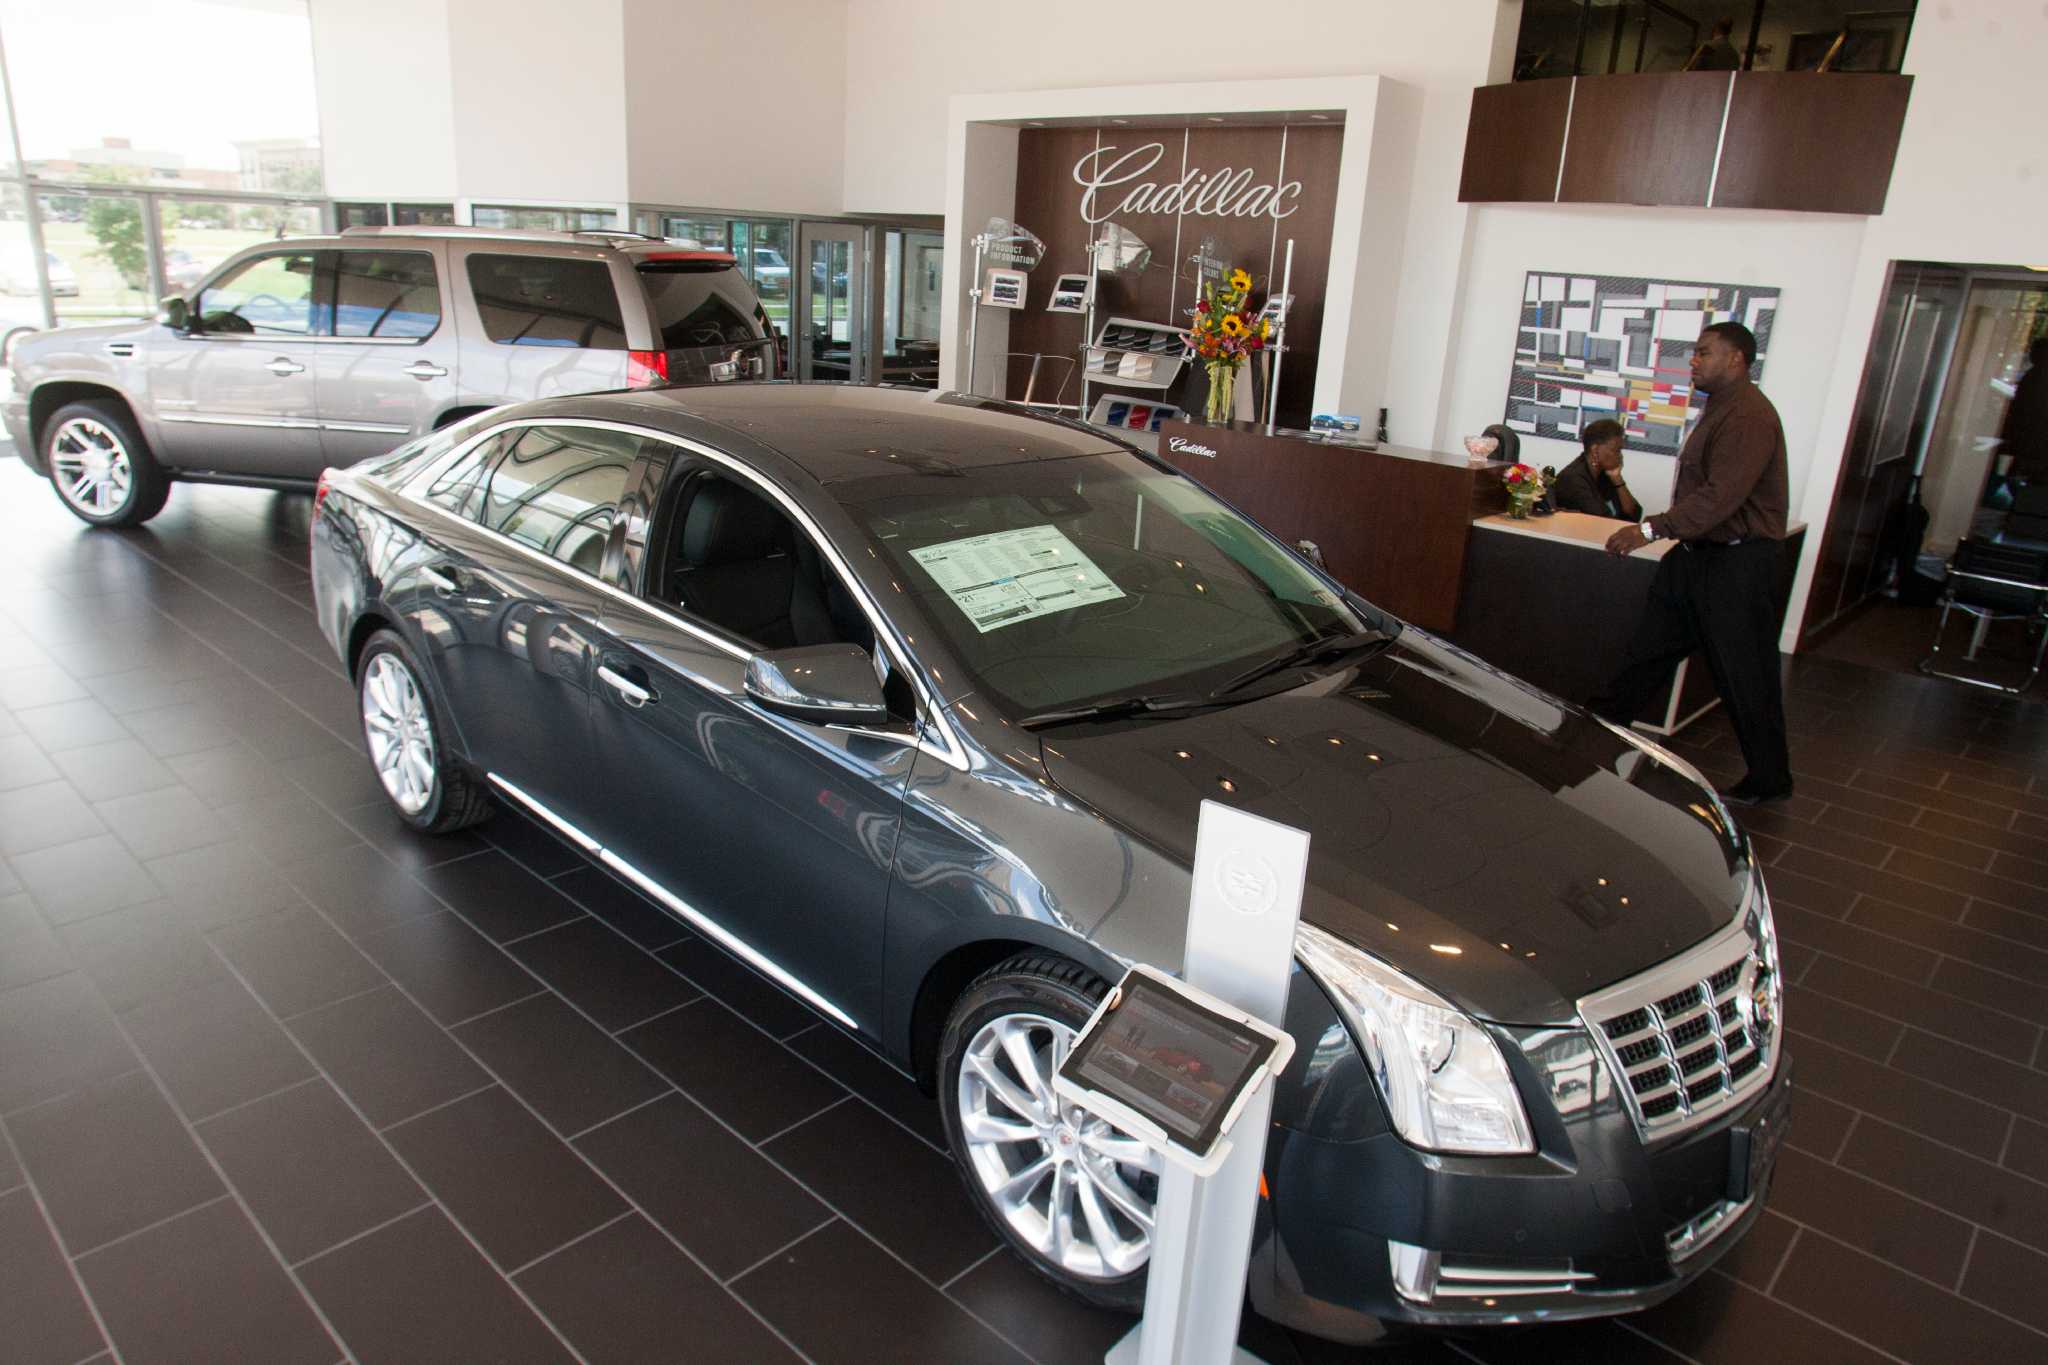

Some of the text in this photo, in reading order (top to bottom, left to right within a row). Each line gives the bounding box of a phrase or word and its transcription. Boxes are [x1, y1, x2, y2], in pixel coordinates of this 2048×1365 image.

[1073, 142, 1302, 224] Cadillac
[991, 243, 1023, 254] PRODUCT
[990, 251, 1036, 265] INFORMATION
[1169, 436, 1217, 458] Cadillac
